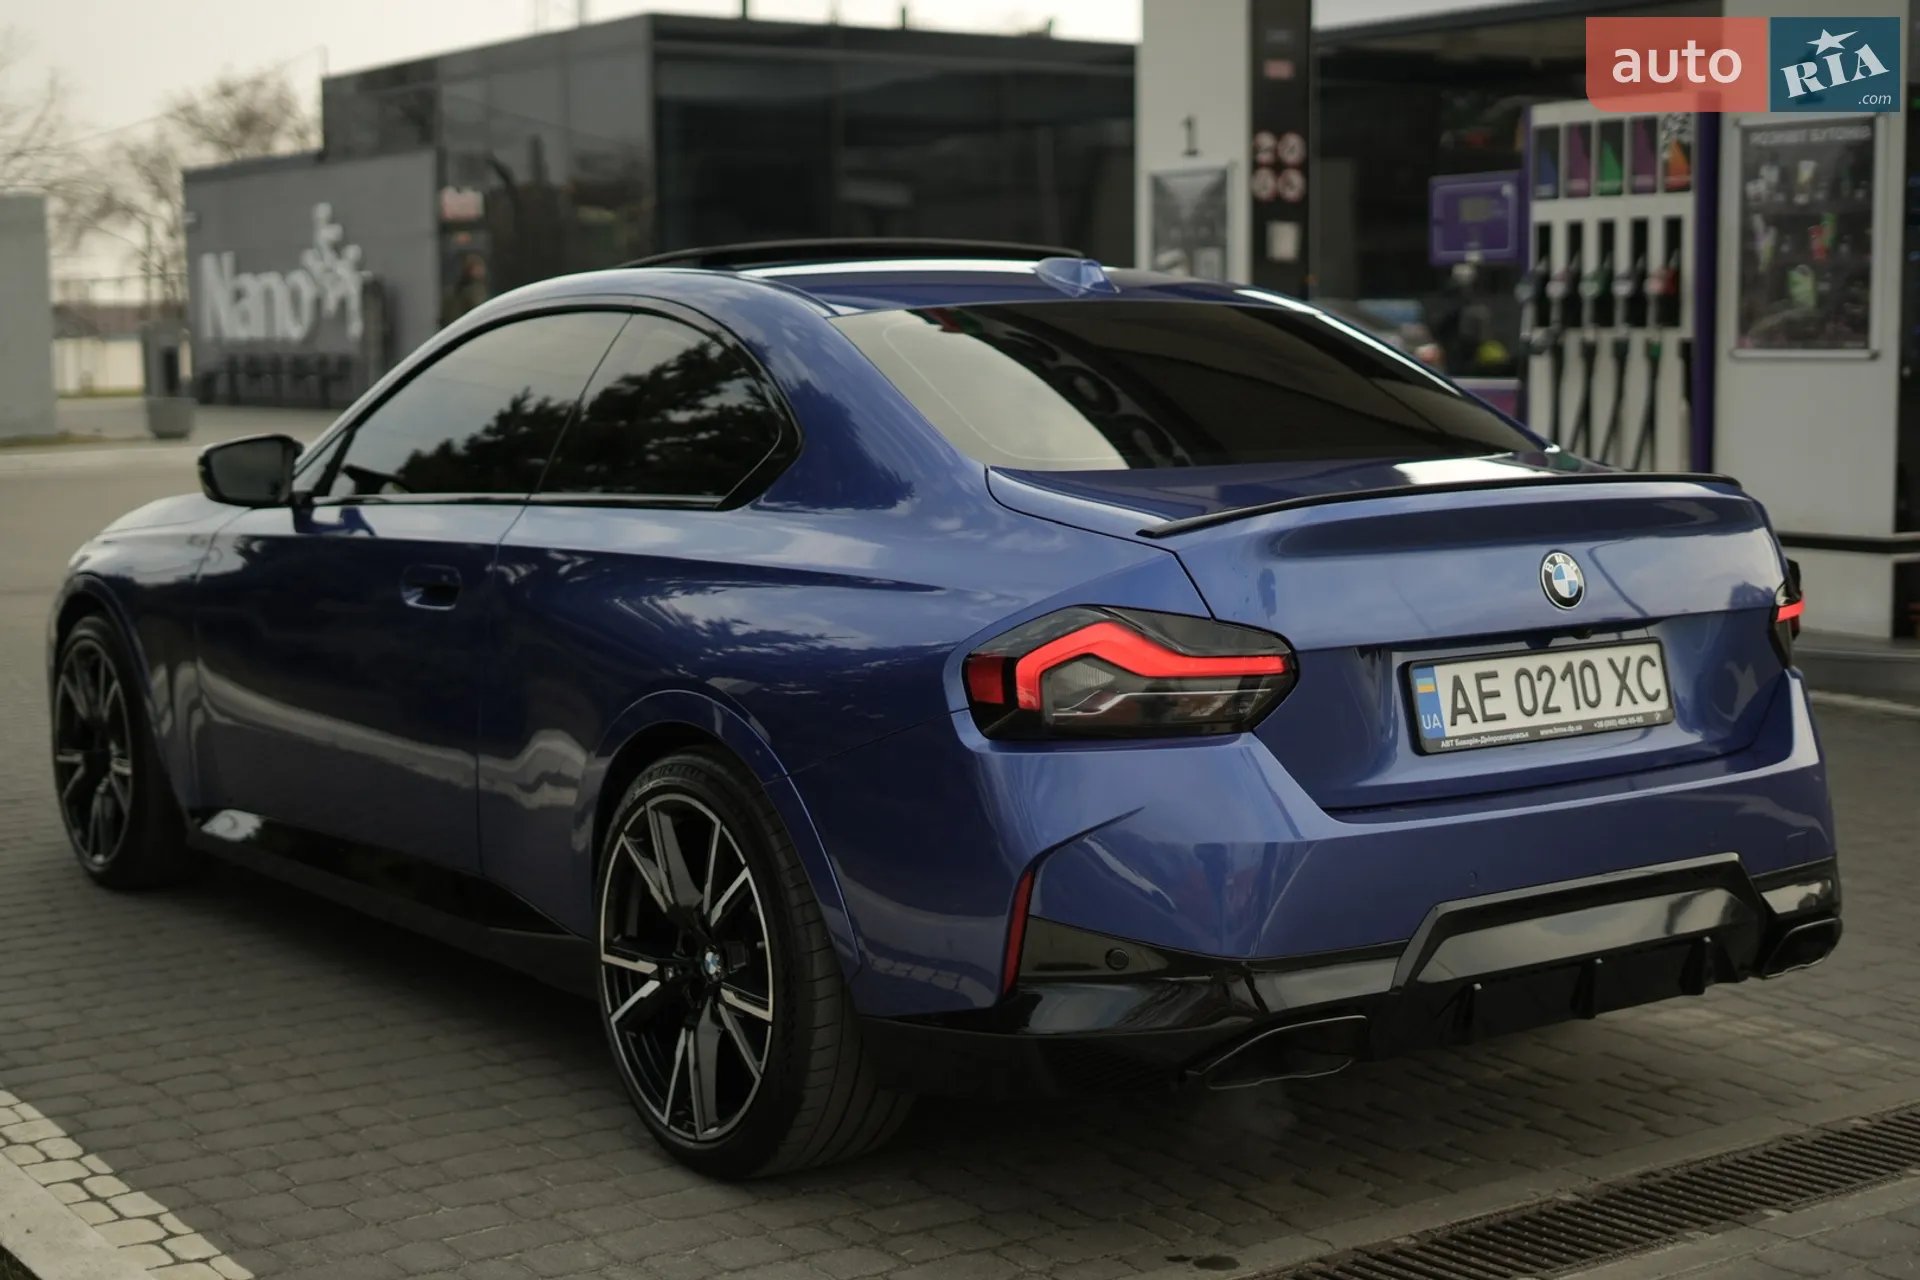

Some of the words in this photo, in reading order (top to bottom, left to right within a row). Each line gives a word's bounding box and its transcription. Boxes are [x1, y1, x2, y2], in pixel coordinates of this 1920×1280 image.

[1180, 113, 1203, 157] 1
[1450, 670, 1506, 727] AE
[1514, 658, 1602, 718] 0210
[1607, 653, 1661, 708] XC
[1421, 713, 1442, 731] UA
